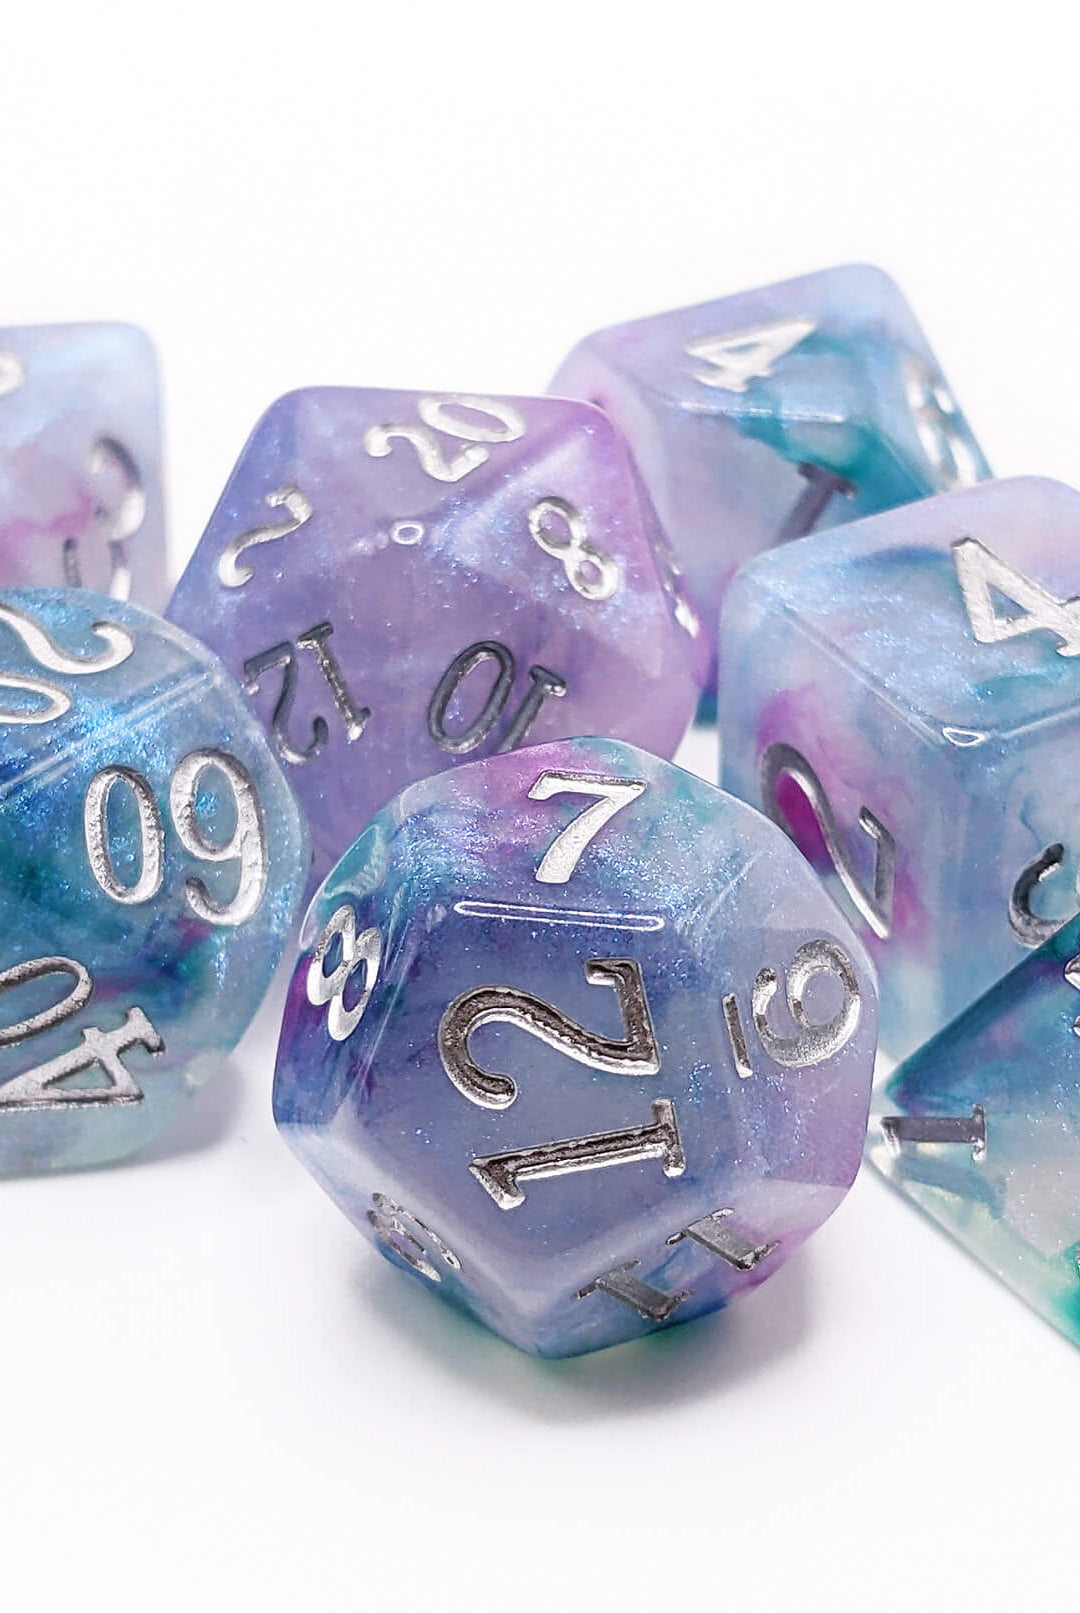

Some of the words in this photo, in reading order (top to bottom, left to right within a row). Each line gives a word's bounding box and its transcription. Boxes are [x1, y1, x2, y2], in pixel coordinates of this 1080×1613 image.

[684, 319, 818, 394] 4
[363, 393, 527, 483] 20
[217, 484, 313, 588] 2
[528, 496, 620, 601] 8
[951, 536, 1080, 658] 4
[242, 621, 372, 766] 12
[427, 640, 568, 754] 10
[528, 769, 648, 884] 7
[306, 904, 383, 1041] 8
[0, 956, 166, 1113] 40
[438, 958, 686, 1210] 12
[880, 1103, 987, 1163] 1
[574, 1206, 782, 1321] 11
